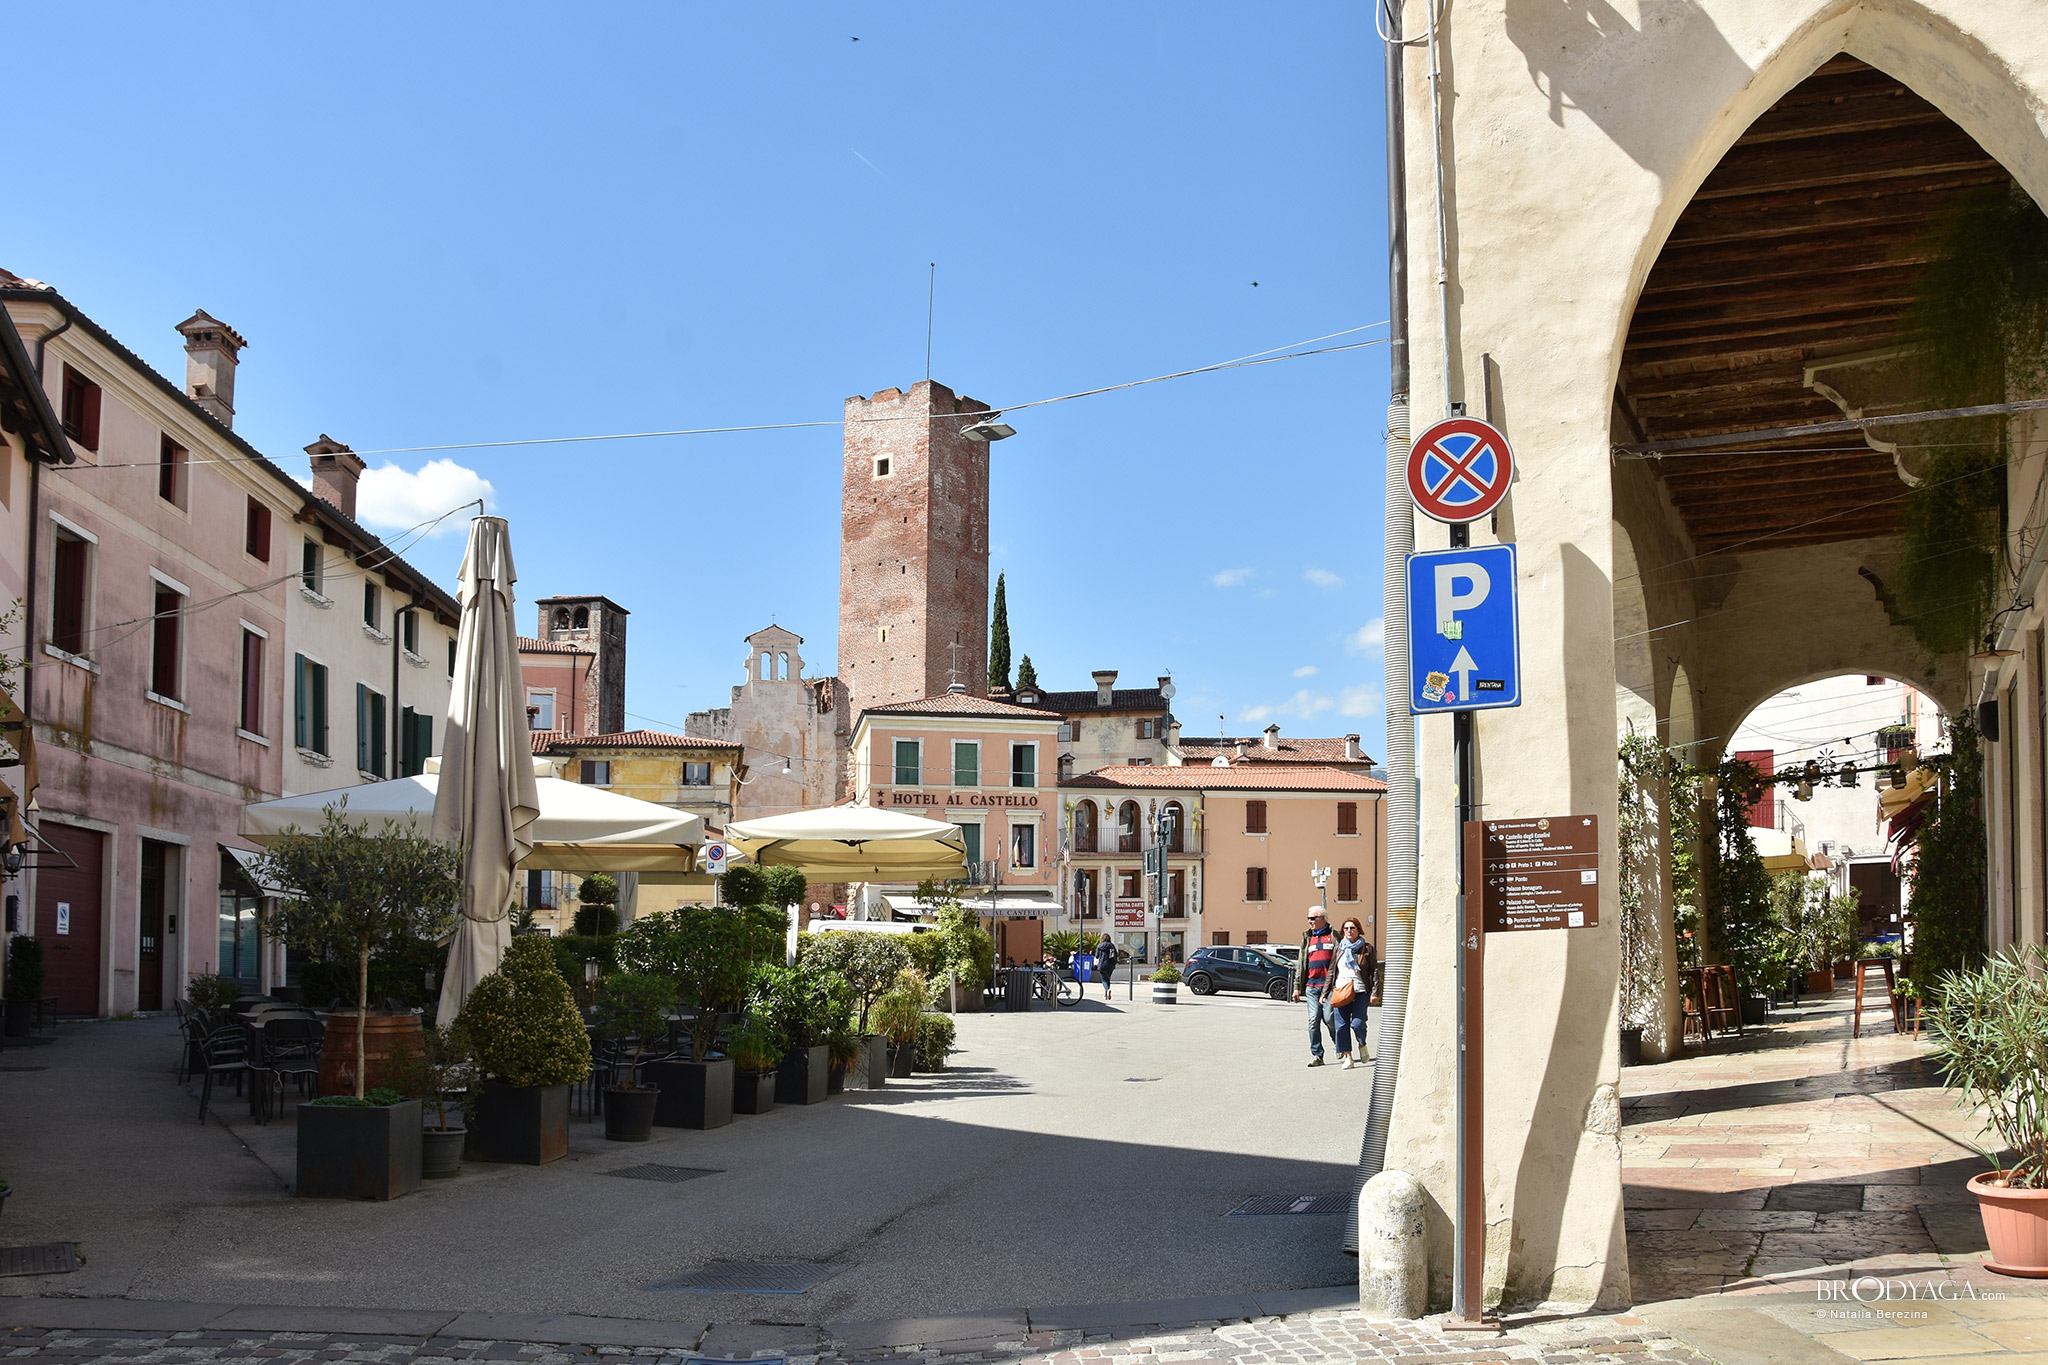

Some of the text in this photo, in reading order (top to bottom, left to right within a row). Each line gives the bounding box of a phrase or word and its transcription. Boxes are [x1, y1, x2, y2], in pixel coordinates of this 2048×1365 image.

[1434, 562, 1490, 634] P
[893, 794, 1038, 806] HOTEL AL CASTELLO
